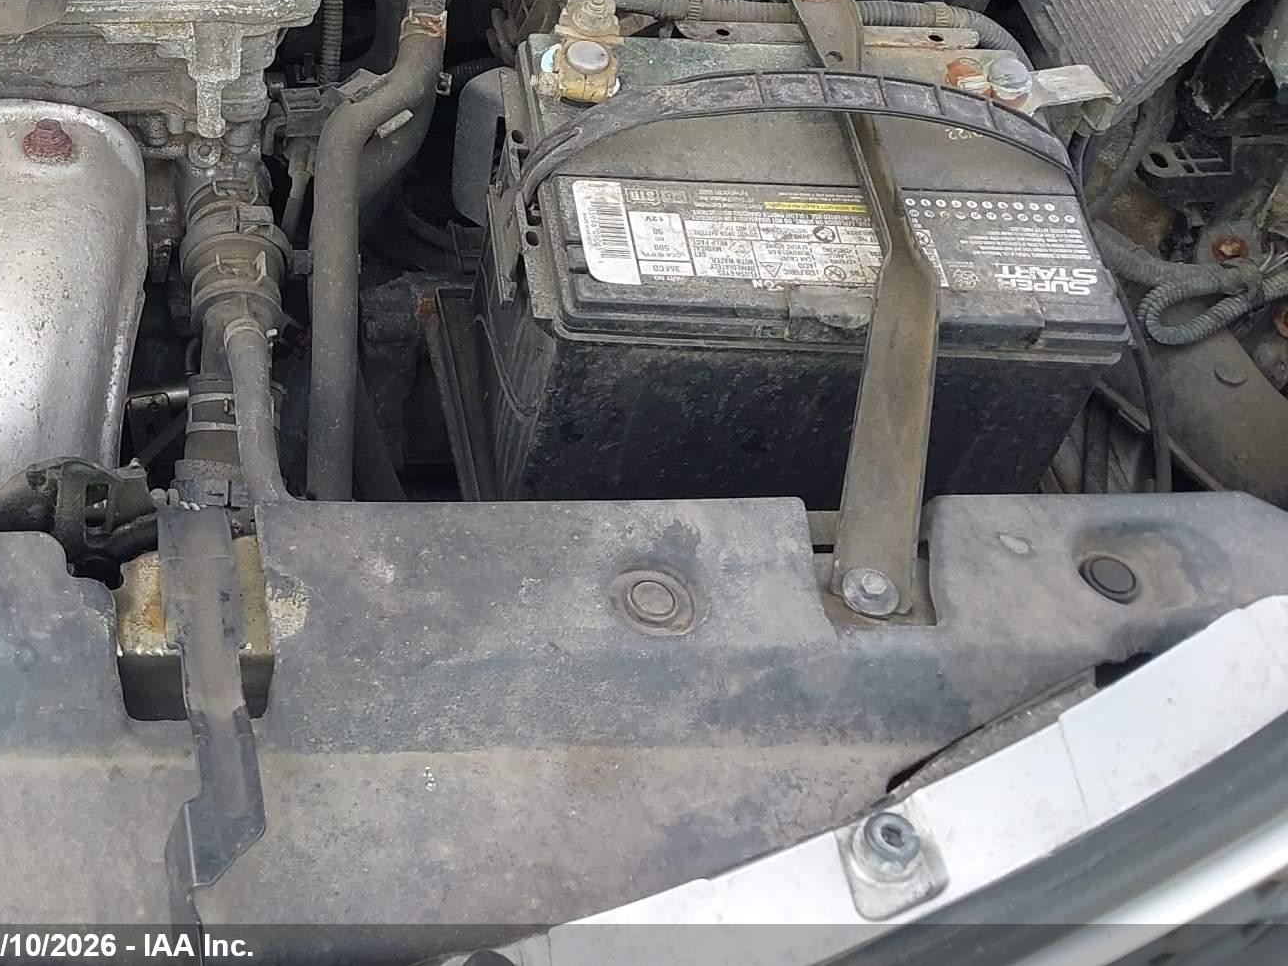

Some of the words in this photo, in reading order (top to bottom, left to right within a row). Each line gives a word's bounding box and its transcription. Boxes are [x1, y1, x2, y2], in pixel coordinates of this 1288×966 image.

[693, 244, 723, 253] MEDICAL
[710, 262, 756, 272] IMMEDIATELY
[735, 258, 754, 266] WITH
[993, 265, 1099, 285] START
[996, 278, 1091, 296] SUPER
